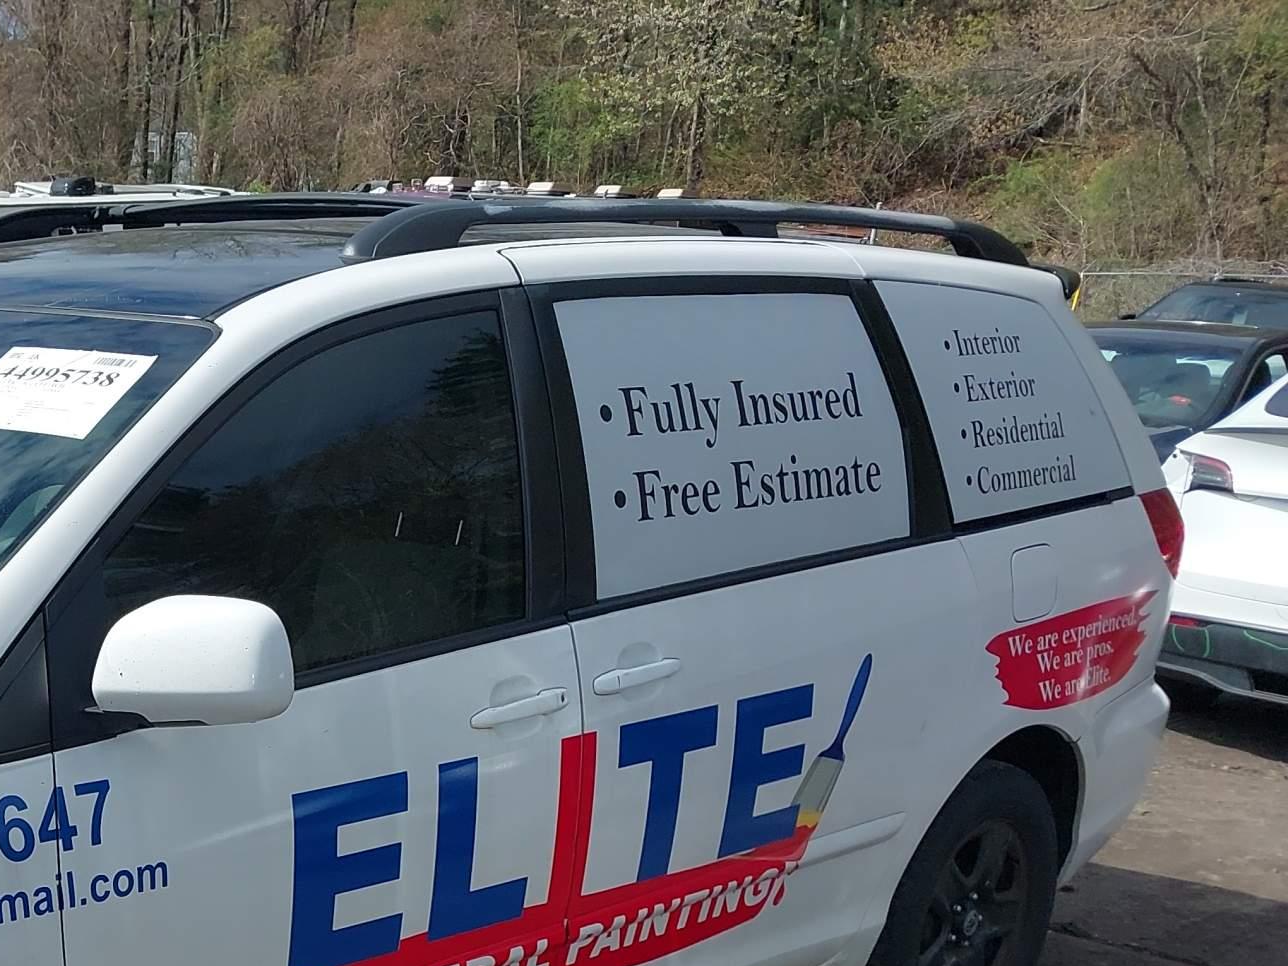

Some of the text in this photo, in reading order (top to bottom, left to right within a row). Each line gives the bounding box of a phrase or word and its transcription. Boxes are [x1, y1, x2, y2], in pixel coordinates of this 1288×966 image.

[952, 327, 1020, 356] Interior
[0, 364, 121, 388] 44995738
[963, 370, 1035, 402] Exterior
[618, 372, 863, 448] Fully Insured
[971, 412, 1065, 449] Residential
[633, 454, 882, 522] Free Estimate
[977, 454, 1077, 495] Commercial
[1008, 605, 1138, 657] We are experienced.
[1037, 641, 1114, 673] We are pros.
[1038, 679, 1063, 703] We
[565, 867, 780, 966] PAINTING
